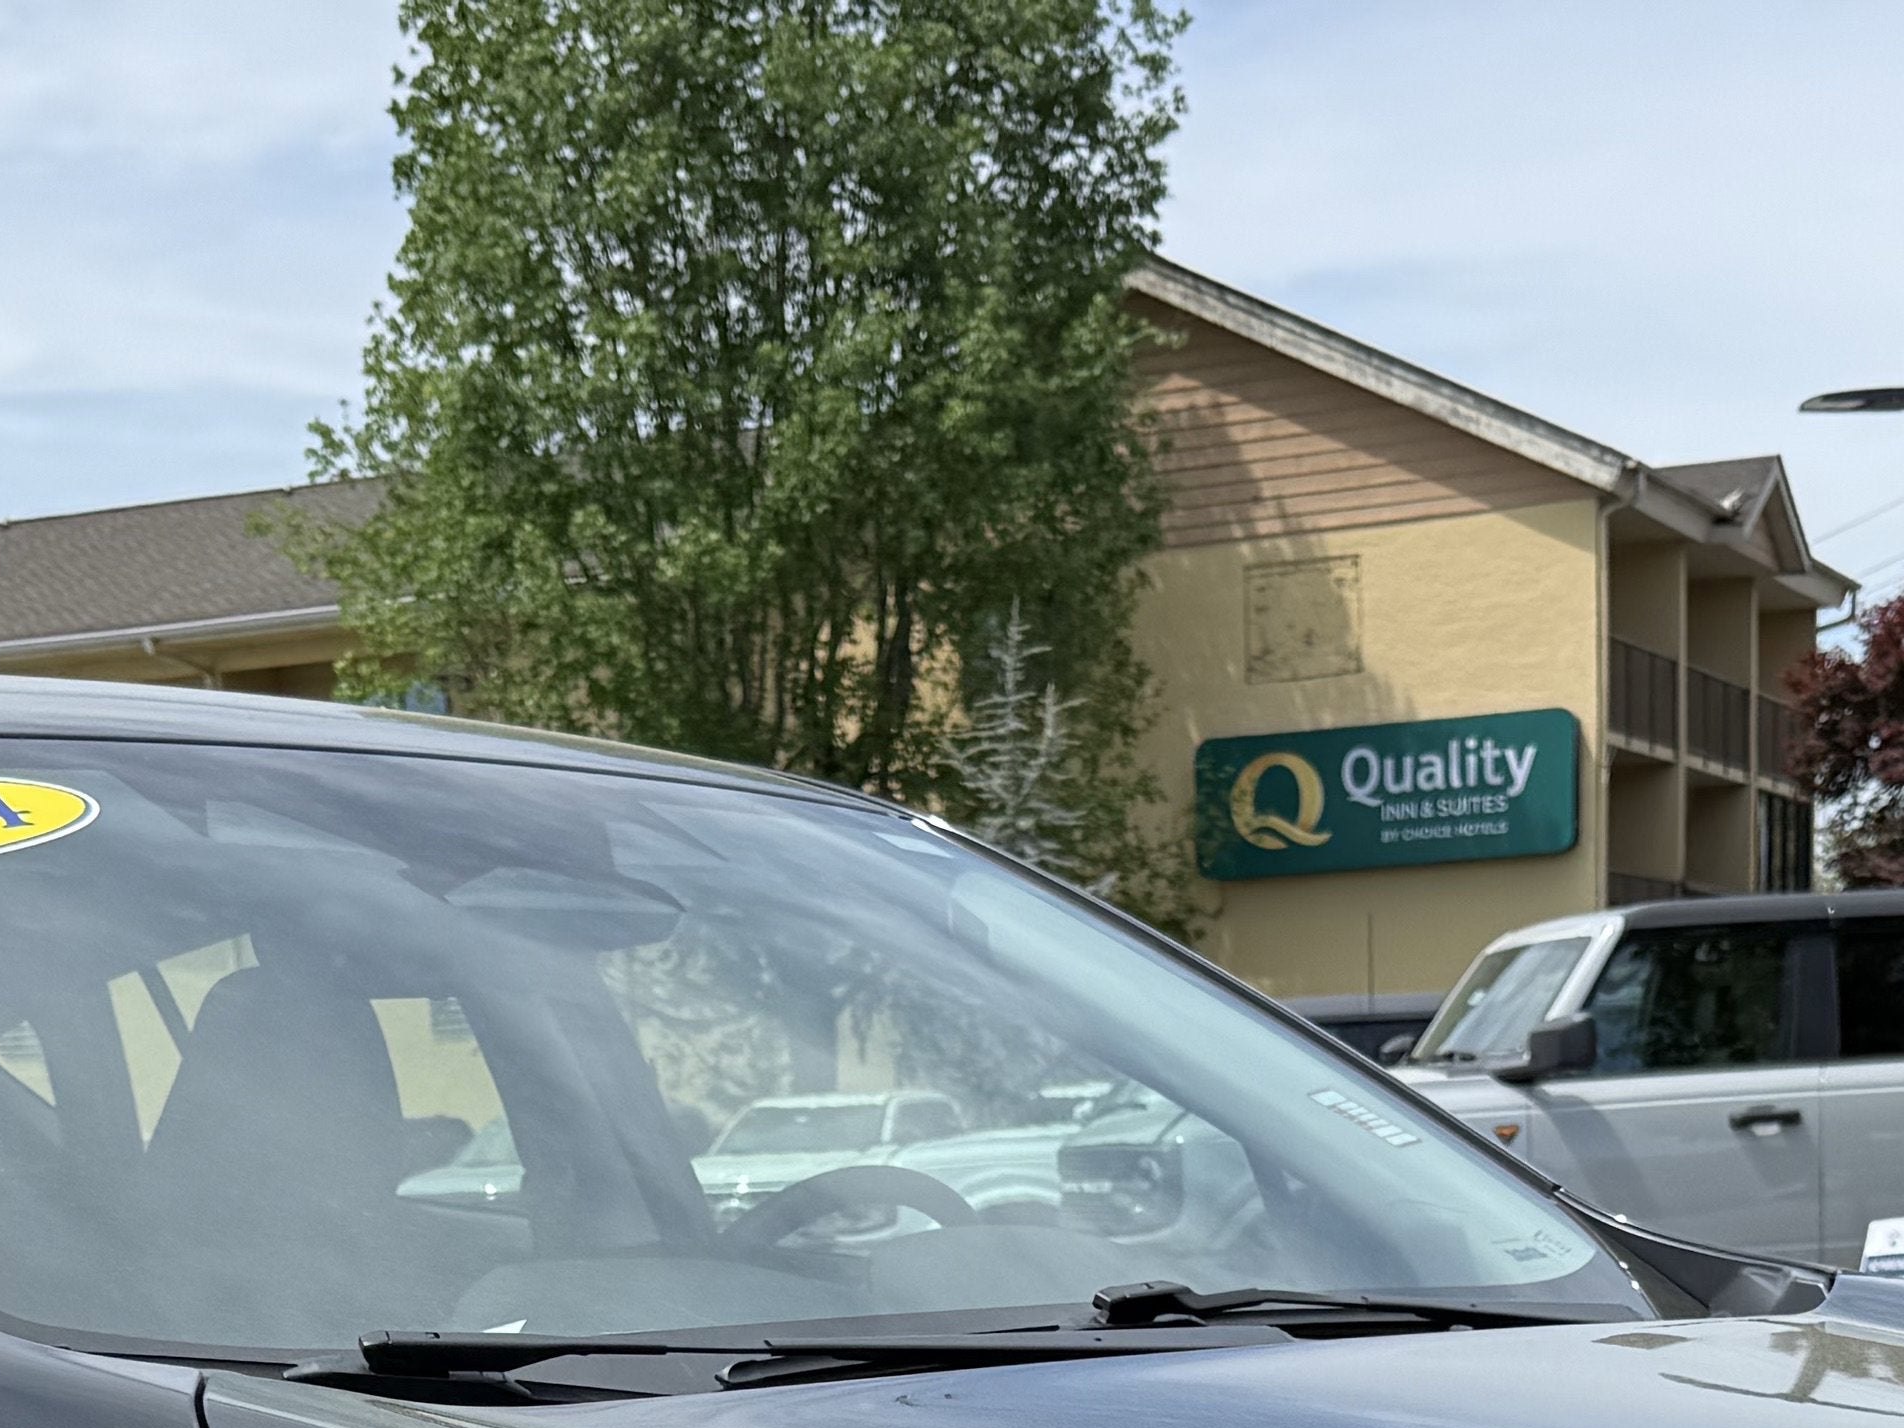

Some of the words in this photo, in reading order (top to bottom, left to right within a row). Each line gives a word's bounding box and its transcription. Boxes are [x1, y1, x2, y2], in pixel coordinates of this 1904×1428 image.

[1229, 752, 1332, 850] Q
[1341, 737, 1537, 807] Quality
[1380, 802, 1418, 822] INN
[1419, 799, 1435, 818] &
[1436, 794, 1509, 817] SUITES
